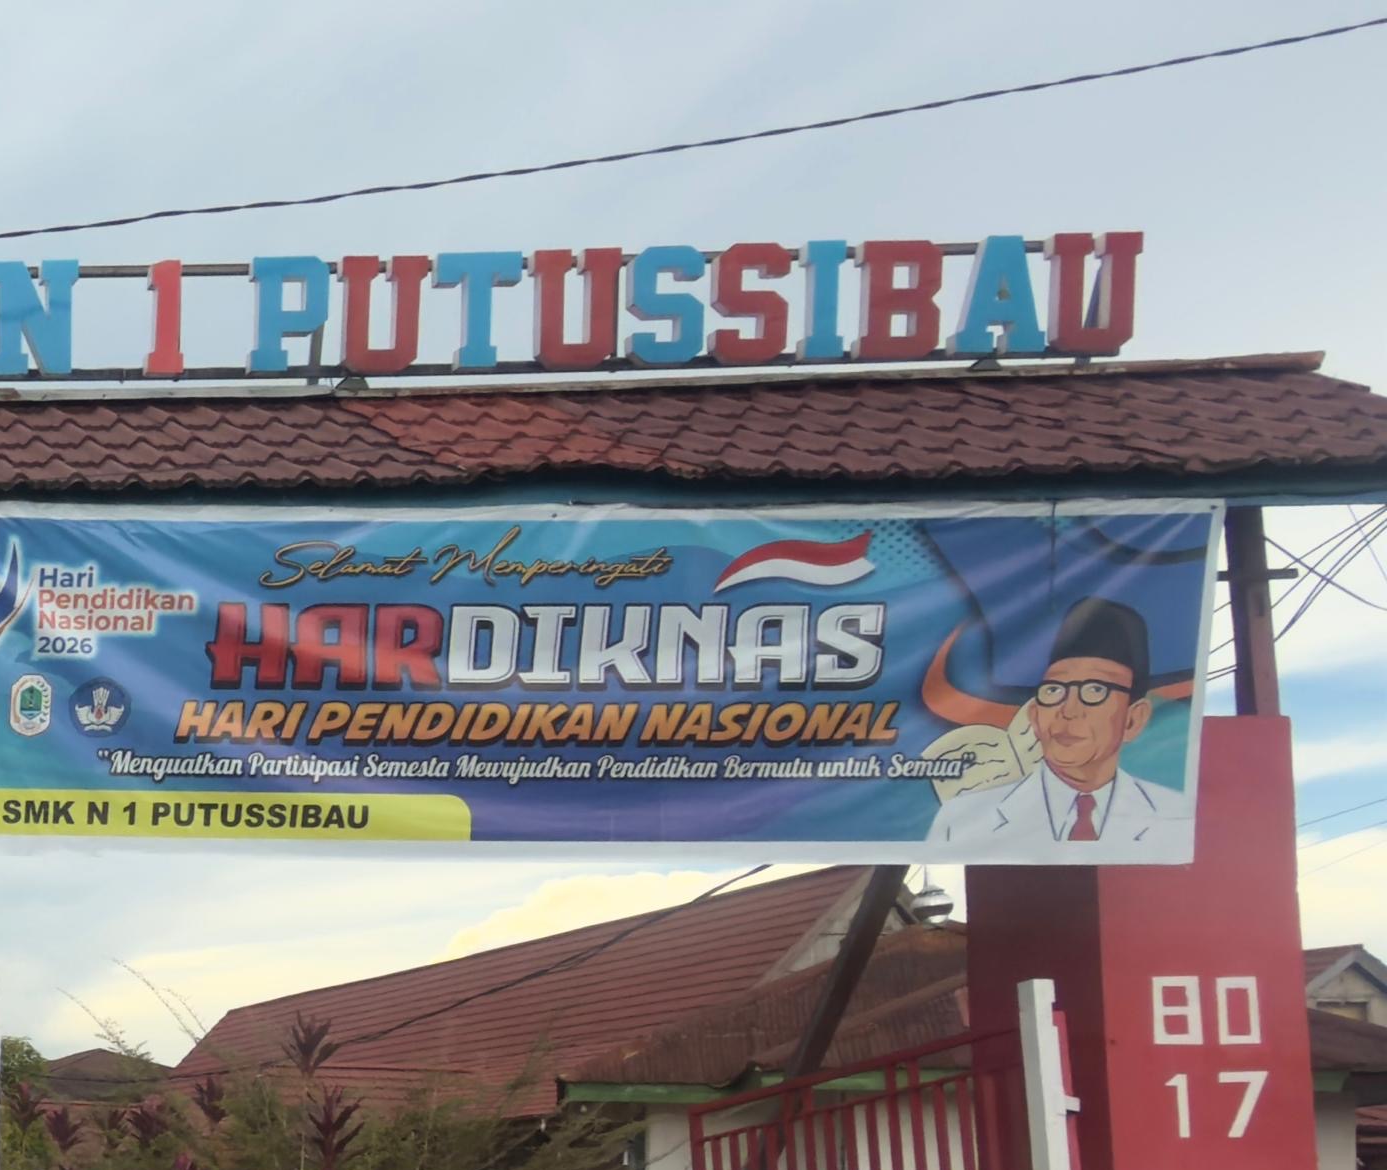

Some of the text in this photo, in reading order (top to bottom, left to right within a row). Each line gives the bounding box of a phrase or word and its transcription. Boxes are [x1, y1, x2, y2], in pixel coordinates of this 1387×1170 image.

[143, 258, 184, 378] 1
[245, 230, 1144, 374] PUTUSSIBAU
[259, 526, 674, 588] Selamat Memperingati
[38, 566, 94, 590] Hari
[38, 589, 195, 611] Pendidikan
[38, 610, 154, 632] Nasional
[37, 636, 93, 655] 2026
[207, 601, 887, 690] HARDIKNAS
[174, 700, 900, 748] HARI PENDIDIKAN NASIONAL
[247, 751, 359, 780] Partisipasi
[363, 752, 449, 779] Semesta
[455, 754, 590, 784] Mewujudkan
[597, 755, 717, 780] Pendidikan
[723, 755, 813, 780] Bermutu
[816, 754, 882, 779] untuk
[2, 800, 369, 829] SMK N 1 PUTUSSIBAU
[1151, 976, 1261, 1045] 80
[1165, 1071, 1269, 1139] 17
